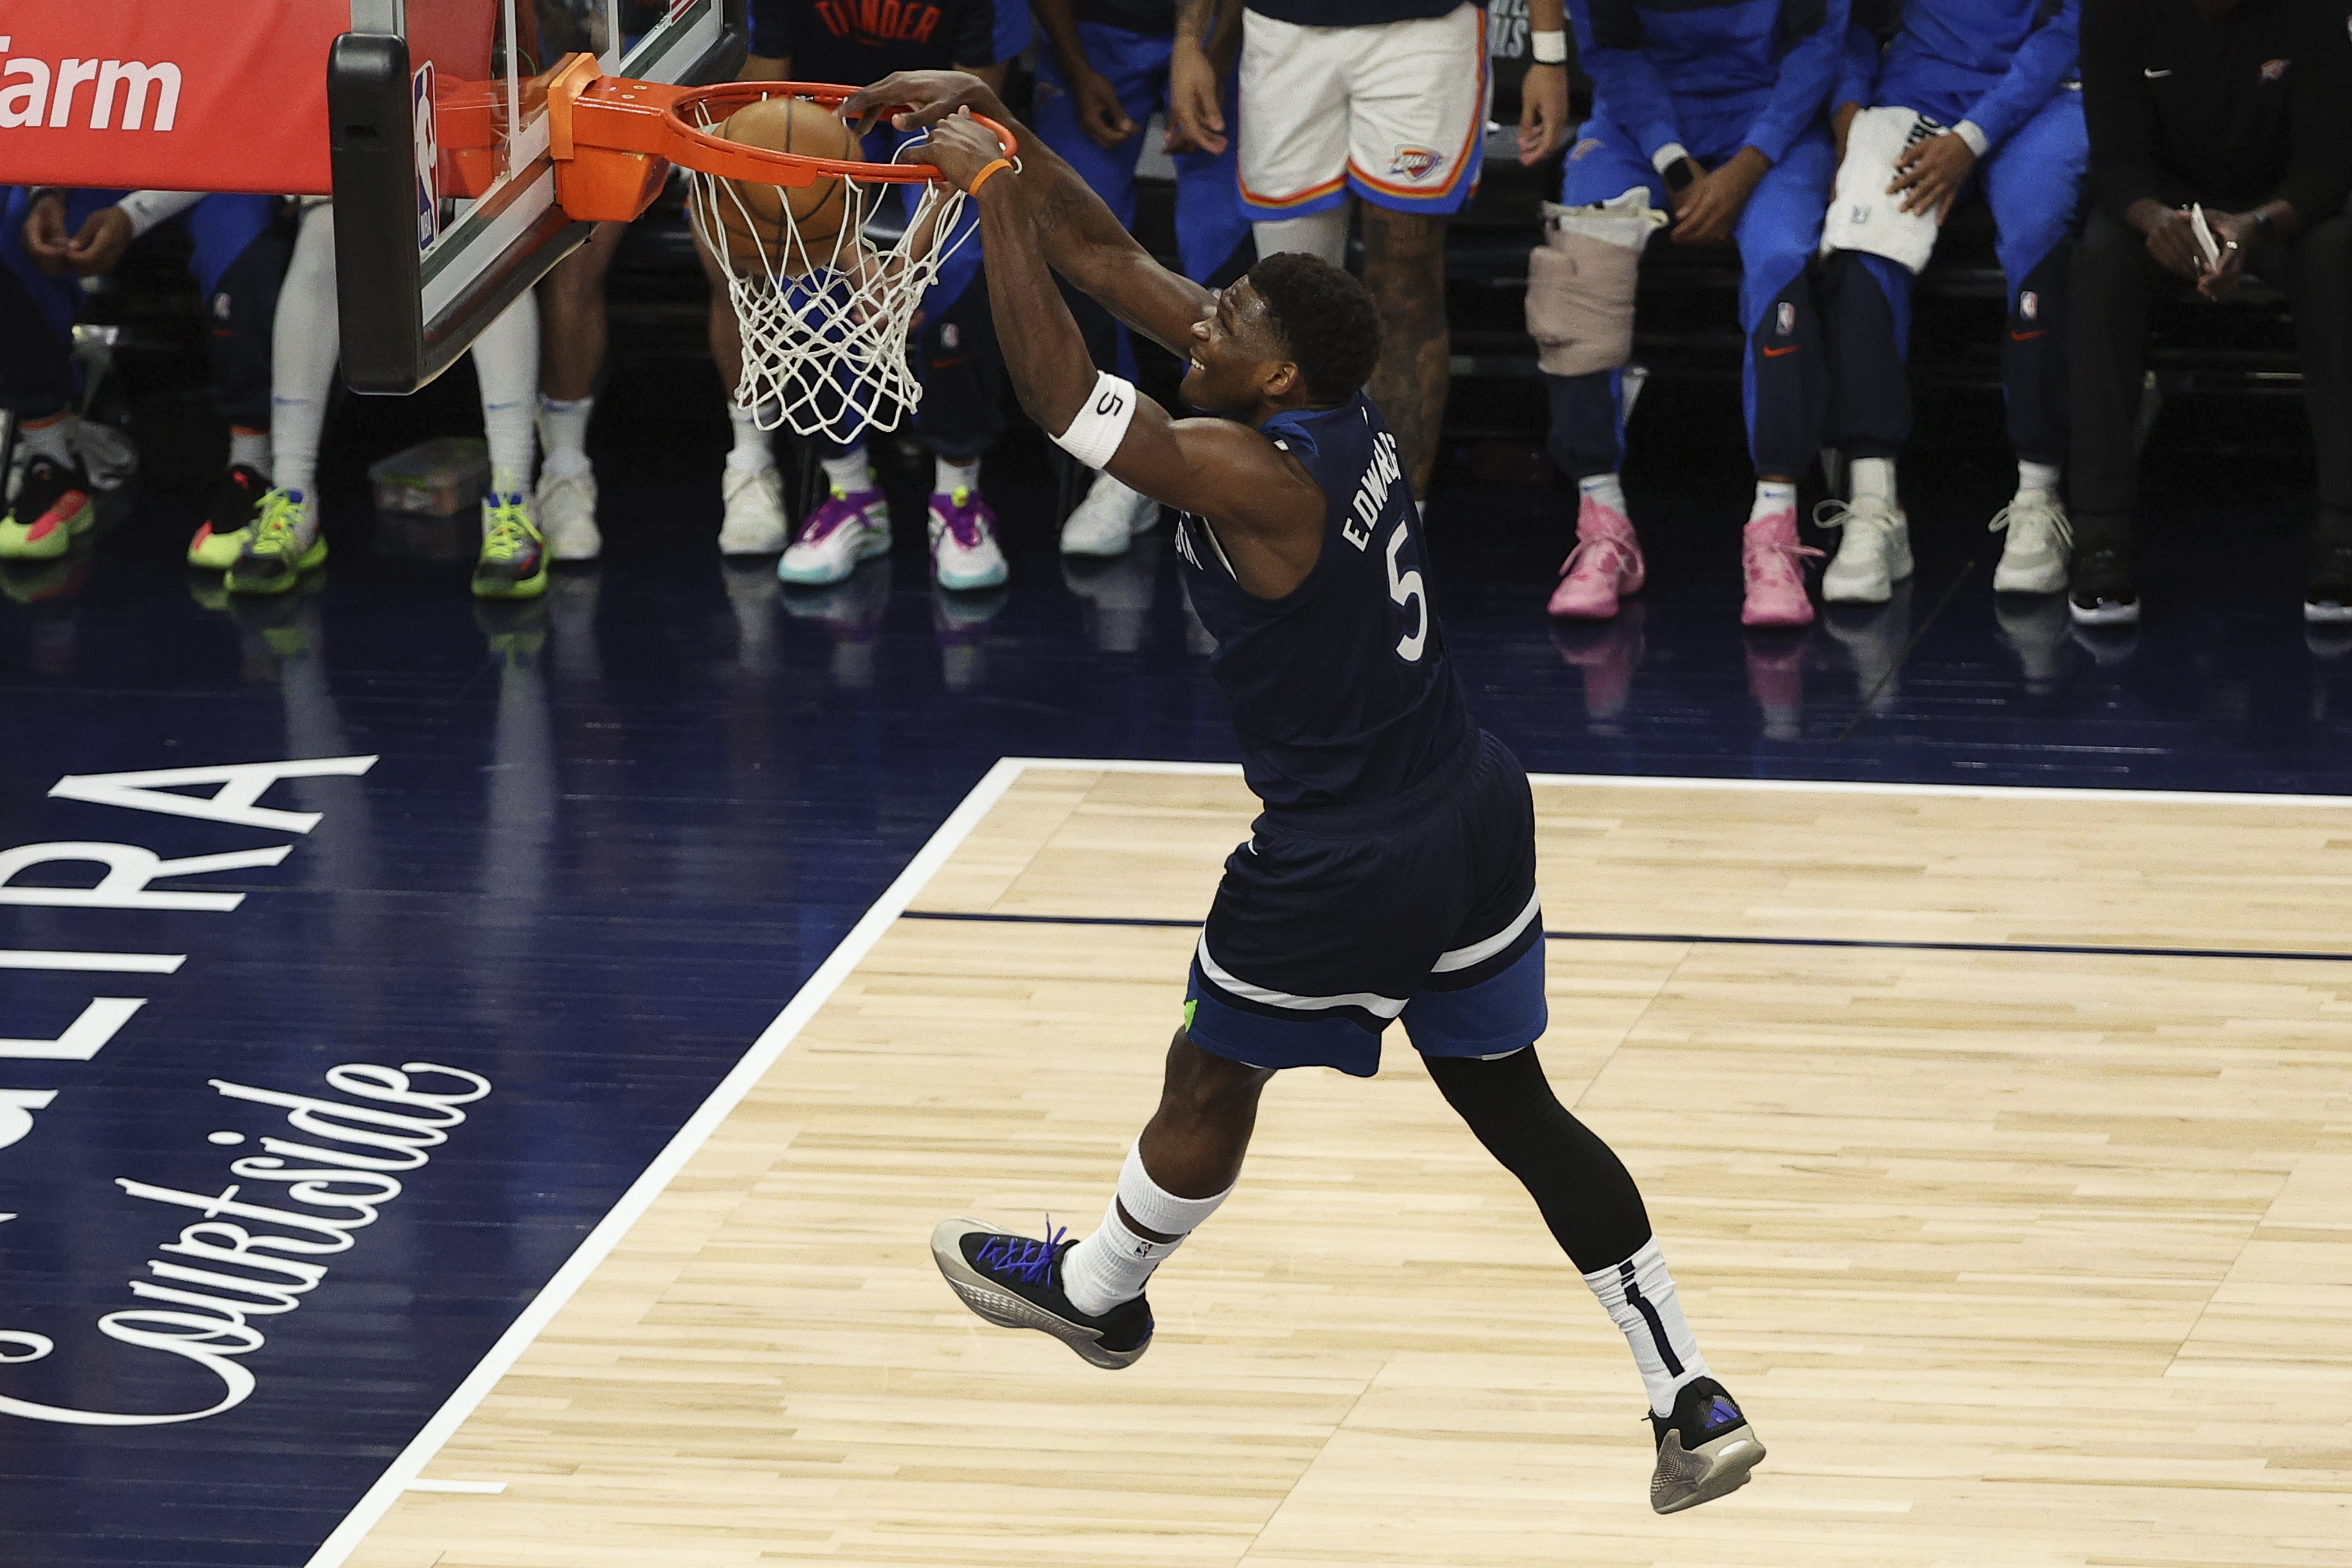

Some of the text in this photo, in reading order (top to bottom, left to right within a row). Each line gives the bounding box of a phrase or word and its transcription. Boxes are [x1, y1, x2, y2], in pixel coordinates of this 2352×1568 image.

[0, 35, 182, 132] arm
[1096, 391, 1123, 416] 5
[1386, 519, 1428, 662] 5
